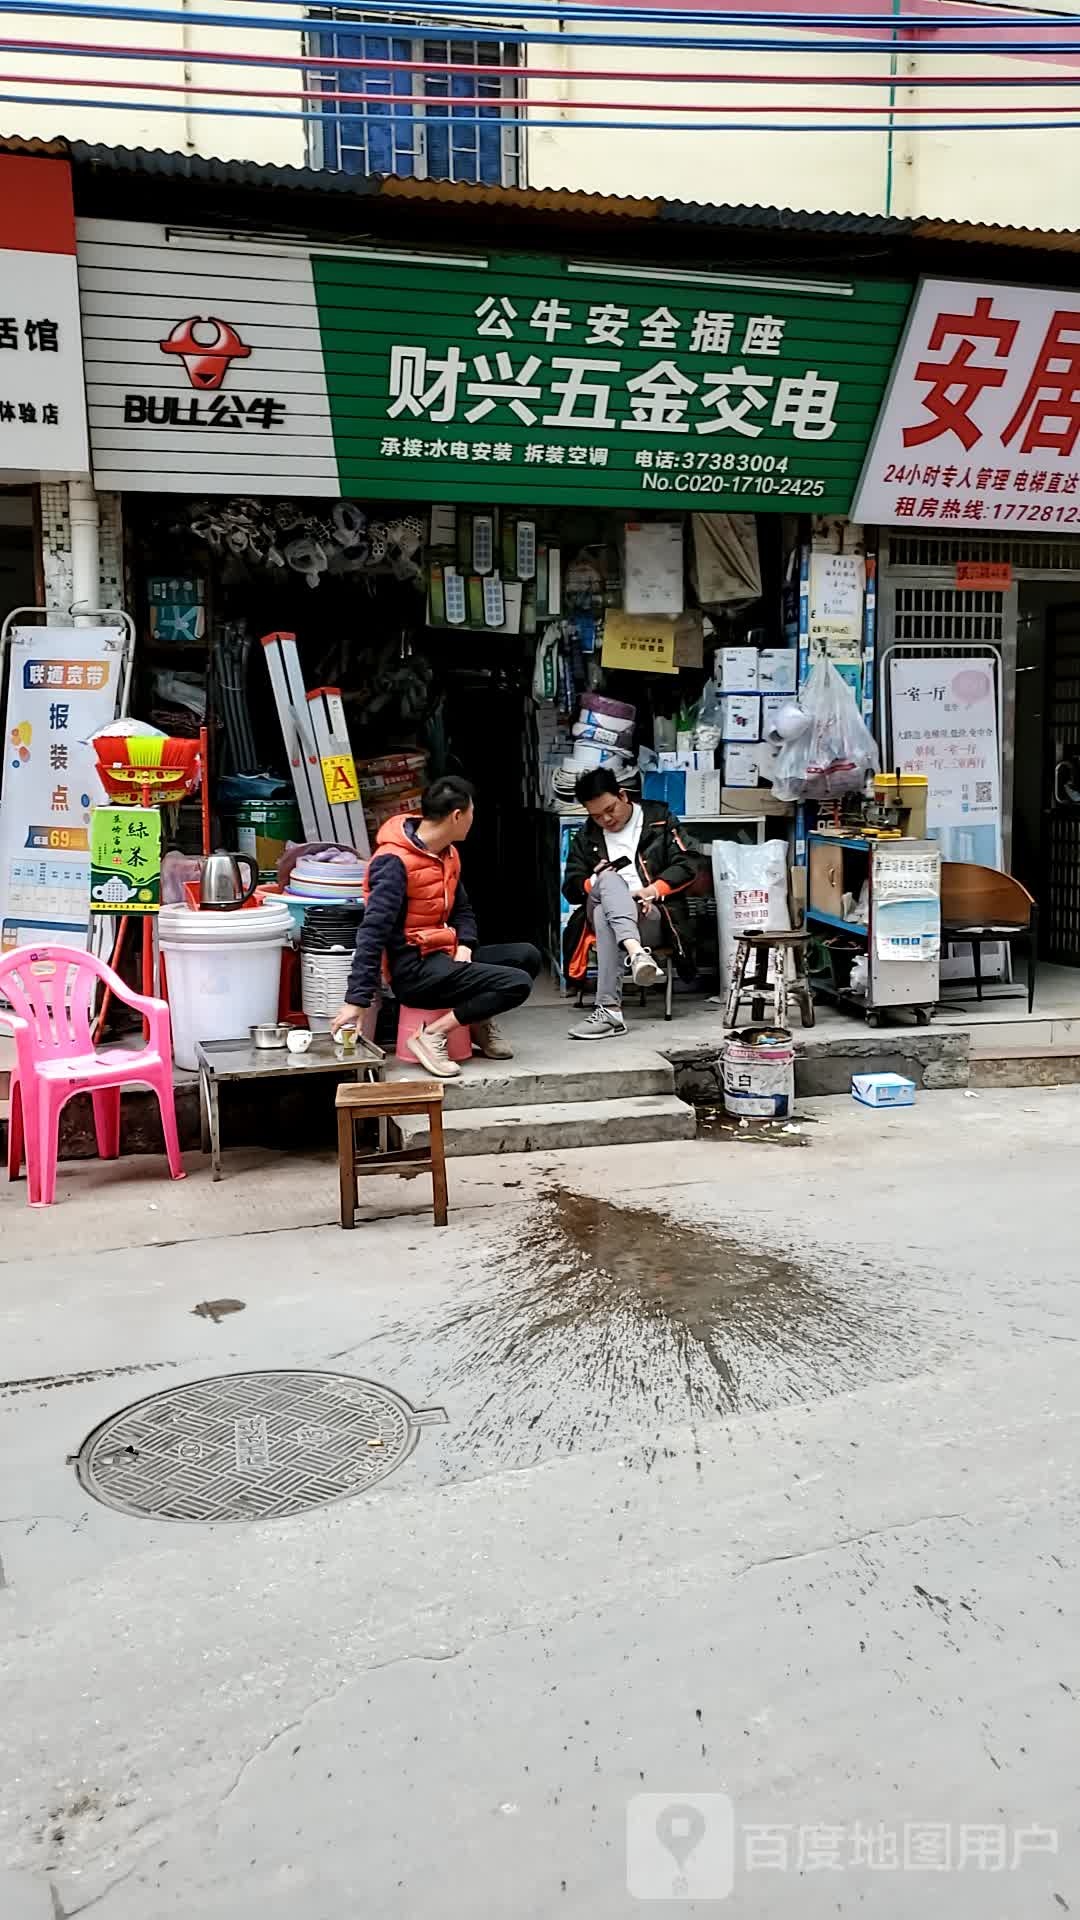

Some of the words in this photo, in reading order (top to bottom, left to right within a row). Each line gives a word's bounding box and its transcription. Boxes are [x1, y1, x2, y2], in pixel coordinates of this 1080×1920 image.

[474, 296, 786, 356] 公牛安全插座
[386, 345, 839, 439] 财兴五金交电
[524, 444, 608, 466] 拆装空调
[635, 450, 789, 473] 电话:37383004
[642, 473, 825, 496] No.C020-1710-2425
[883, 464, 1012, 491] 24小时专人管理
[894, 497, 1080, 524] 租房热线:1772812
[29, 665, 104, 686] 联通宽带
[896, 686, 946, 701] 一室一厅
[49, 703, 69, 811] 报装点
[330, 765, 354, 791] A
